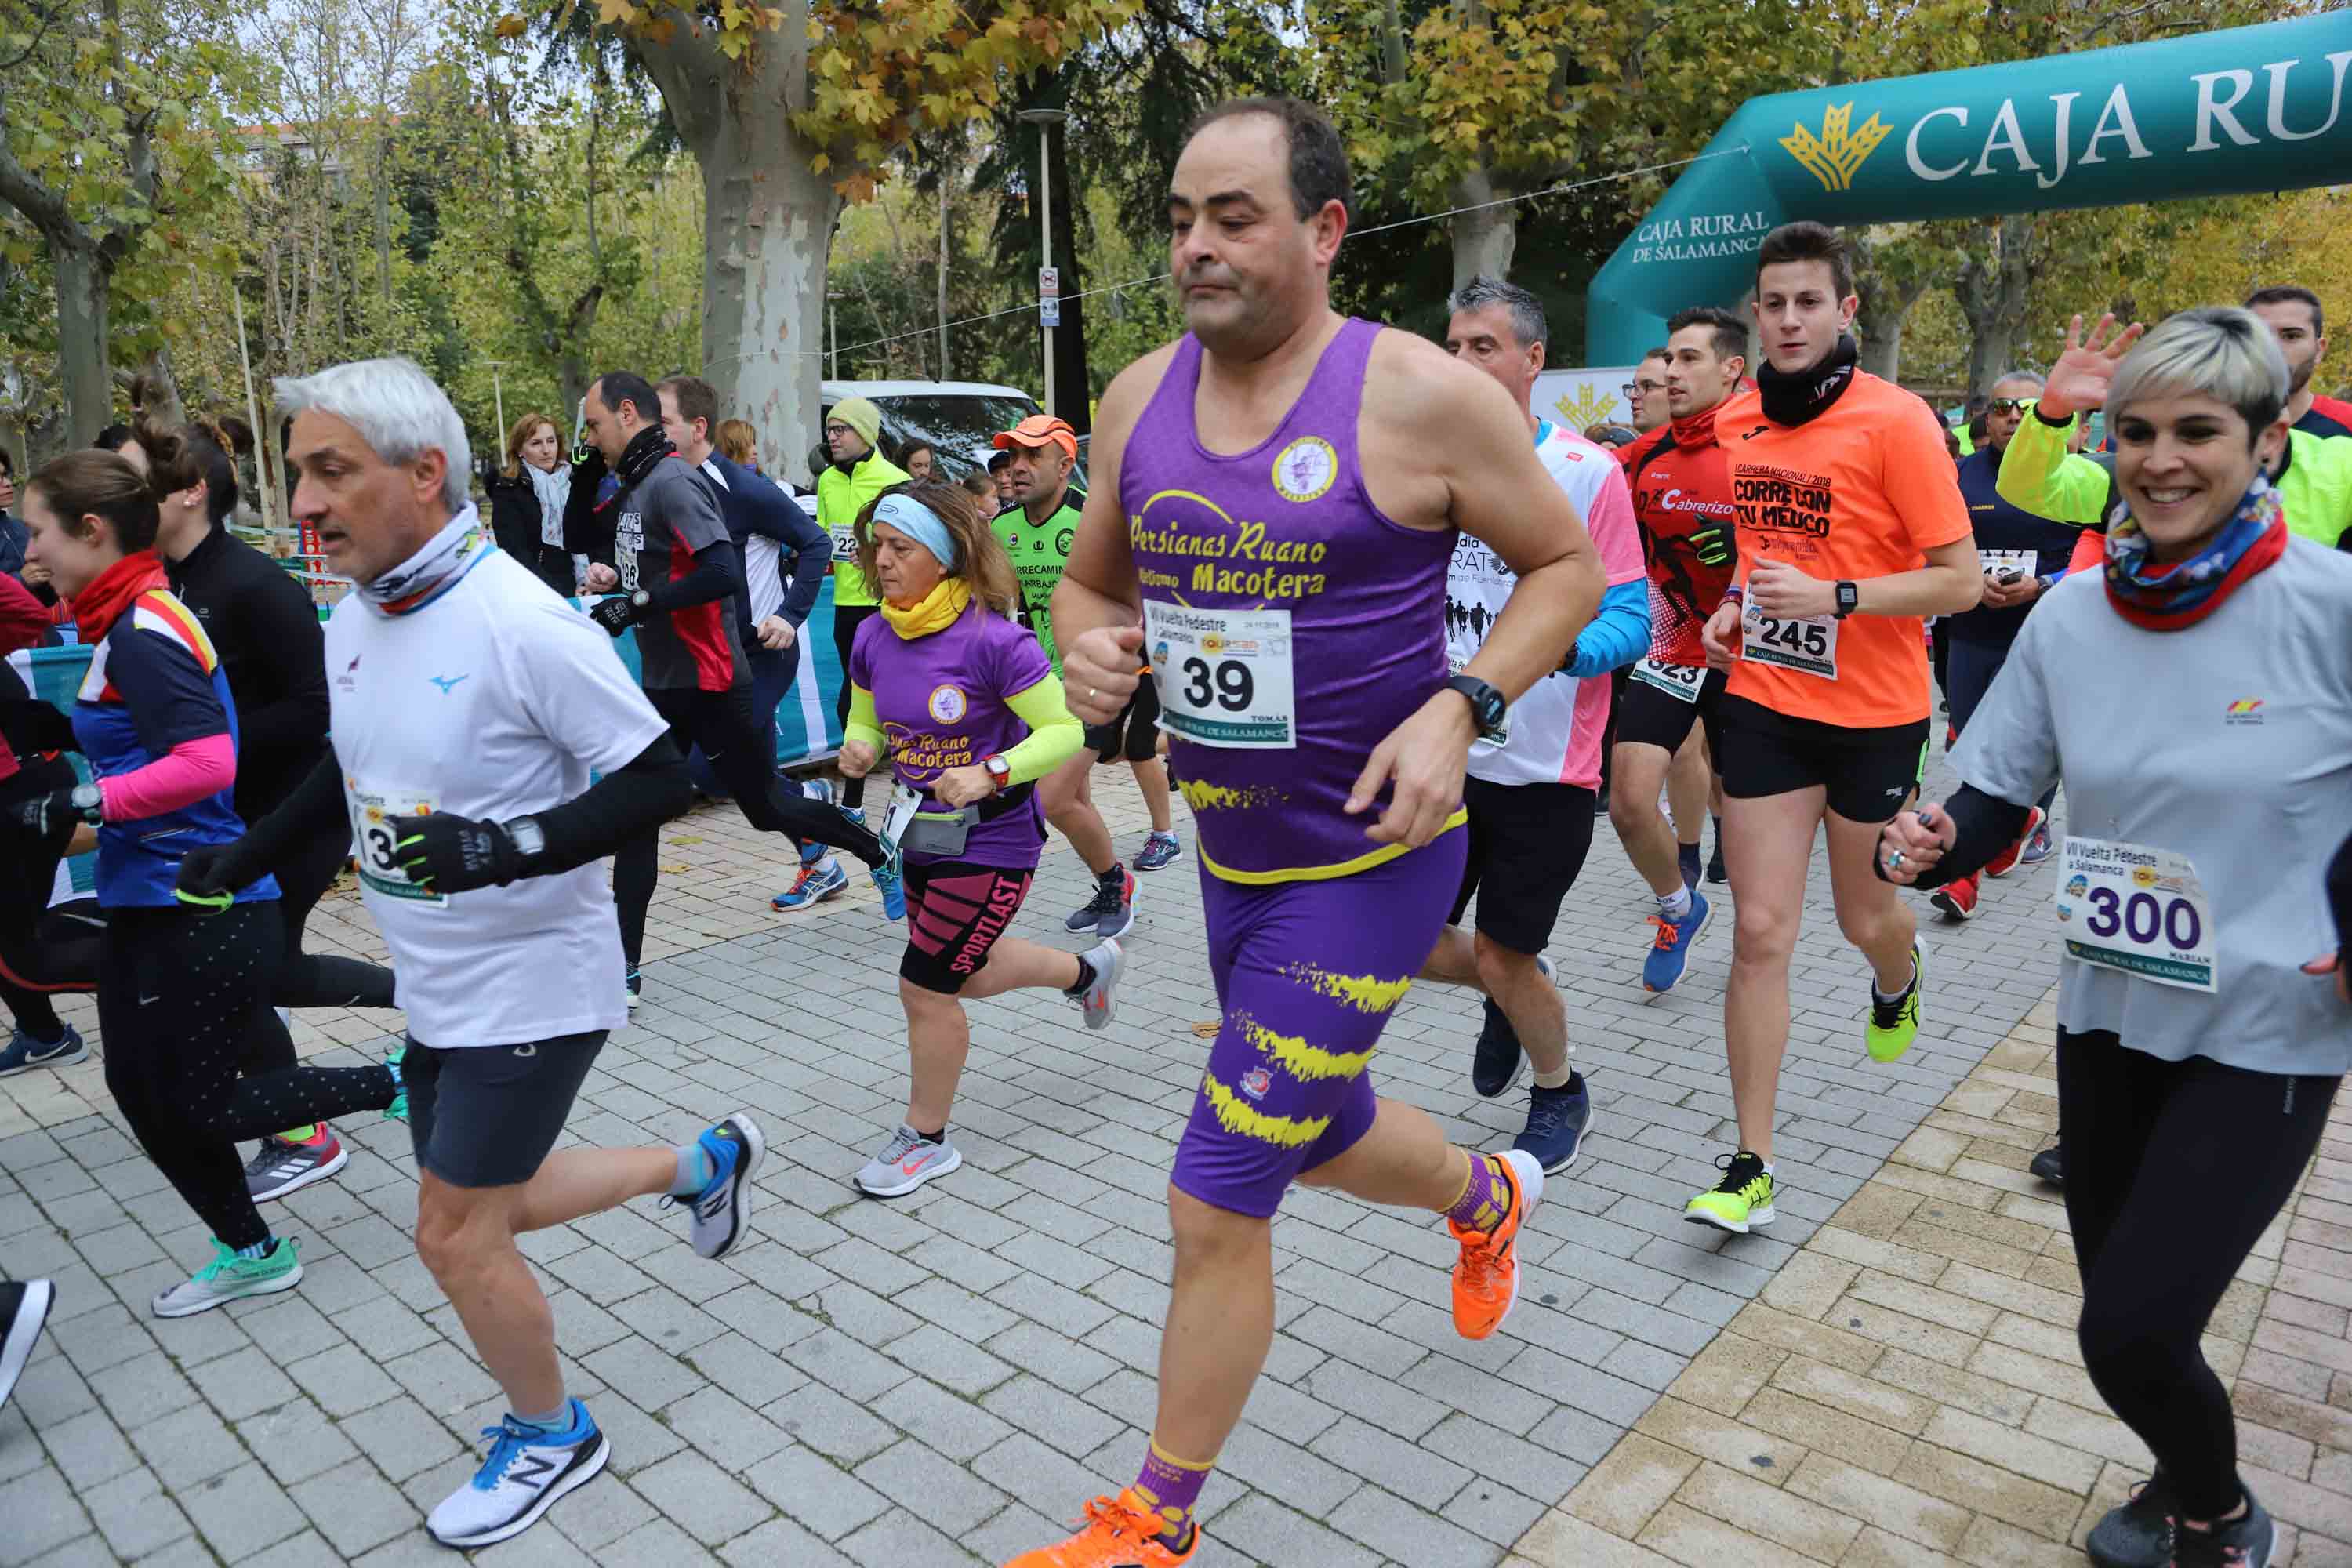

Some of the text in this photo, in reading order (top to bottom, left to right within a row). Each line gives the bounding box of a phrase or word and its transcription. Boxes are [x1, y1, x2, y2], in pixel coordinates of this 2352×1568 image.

[1905, 82, 2154, 189] CAJA
[1637, 211, 1769, 245] CAJA RURAL
[1632, 246, 1653, 263] DE
[1771, 467, 1806, 484] NACIONAL
[1812, 474, 1832, 488] 2018
[1661, 488, 1734, 515] Cabrerizo
[1735, 503, 1758, 525] TU
[1130, 514, 1327, 564] Persianas Ruano
[1192, 563, 1327, 601] Macotera
[1760, 616, 1827, 657] 245
[1183, 655, 1254, 713] 39
[896, 747, 972, 768] Macotera
[914, 734, 969, 751] Ruano
[2075, 859, 2125, 877] Salamanca
[2079, 844, 2111, 862] Vuelta
[2114, 848, 2158, 868] Pedestre
[950, 876, 1021, 974] SPORTLAST
[2087, 886, 2201, 950] 300
